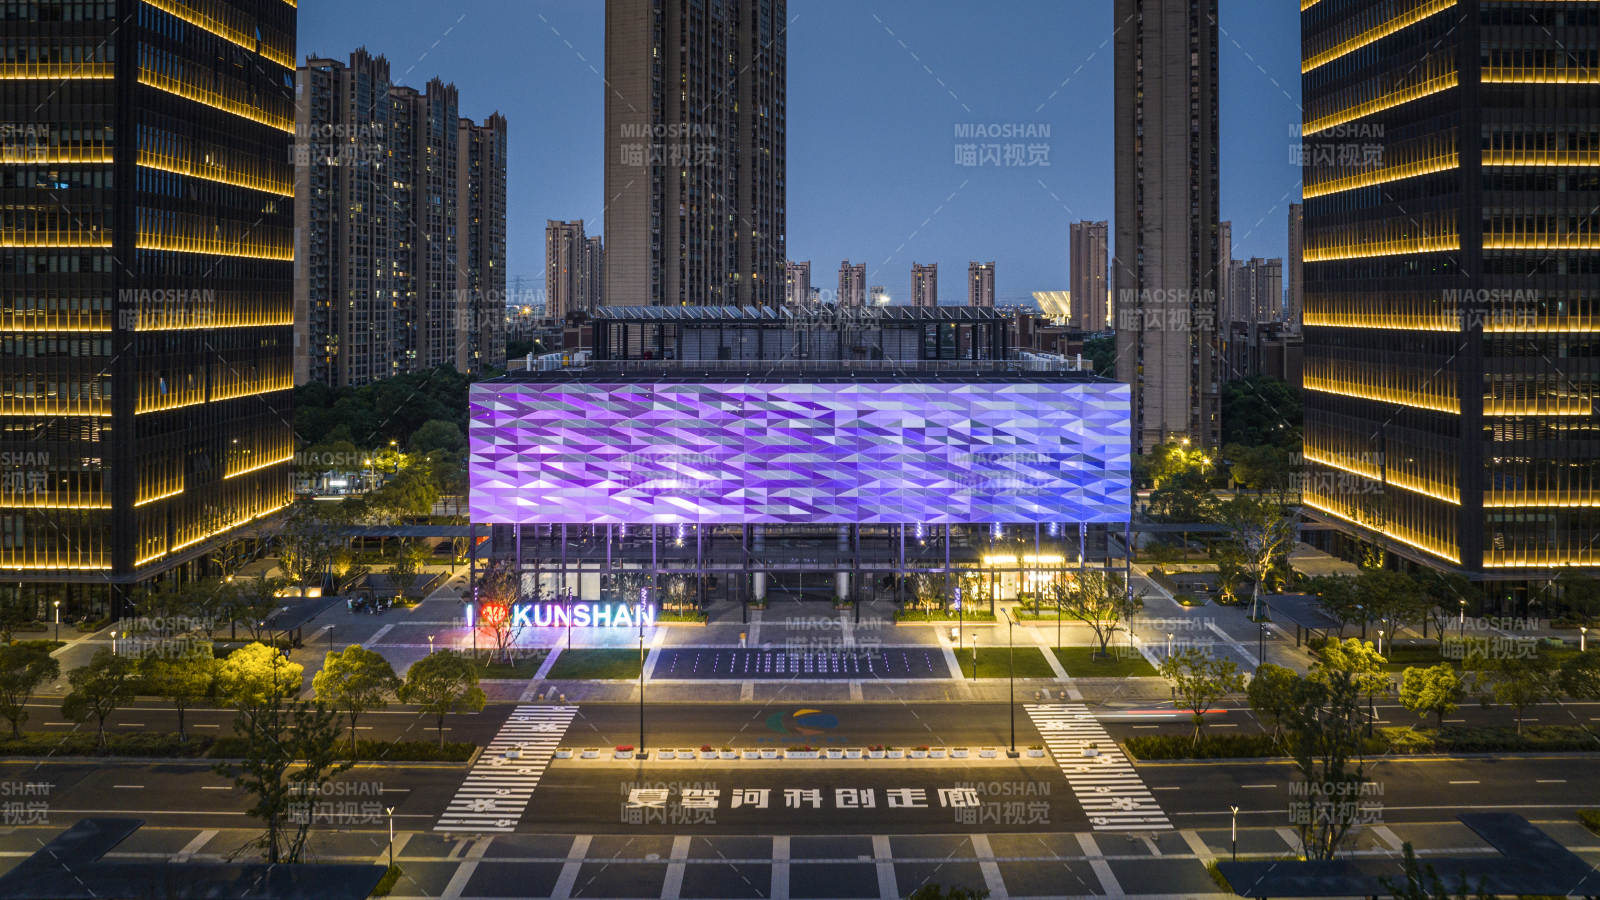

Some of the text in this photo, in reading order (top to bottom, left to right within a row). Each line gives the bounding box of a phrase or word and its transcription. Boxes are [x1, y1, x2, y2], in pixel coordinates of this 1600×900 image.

[466, 604, 473, 627] I
[513, 604, 654, 627] KUNSHAN
[626, 788, 980, 809] 夏驾河科创走廊
